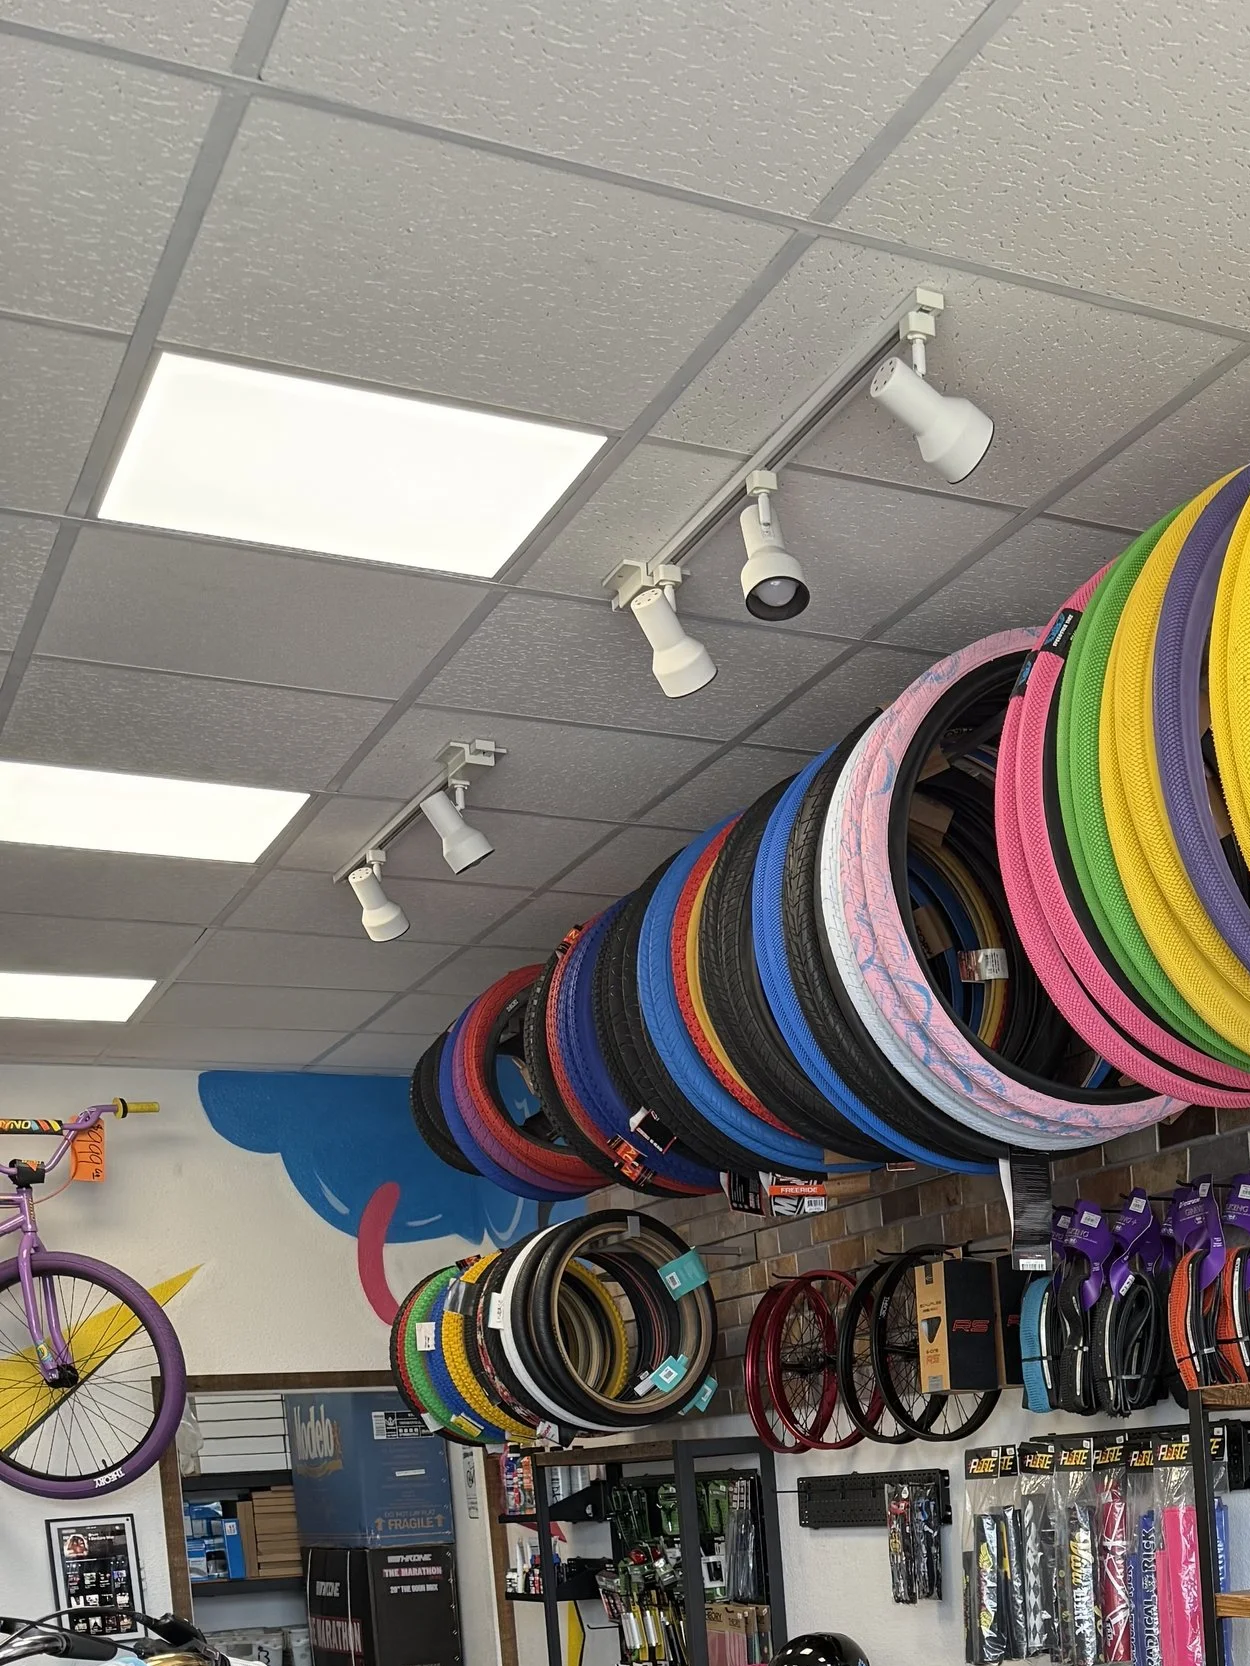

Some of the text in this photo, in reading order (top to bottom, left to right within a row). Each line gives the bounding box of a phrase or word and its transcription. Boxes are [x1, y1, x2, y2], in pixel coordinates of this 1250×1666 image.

[952, 1319, 990, 1333] RS
[1059, 1449, 1089, 1466] FLITE
[1129, 1450, 1154, 1467] FLIT
[1157, 1443, 1190, 1461] FLITE
[387, 1517, 434, 1530] FRAGILE
[1141, 1525, 1156, 1574] RICK
[383, 1566, 442, 1578] THE MARATHON
